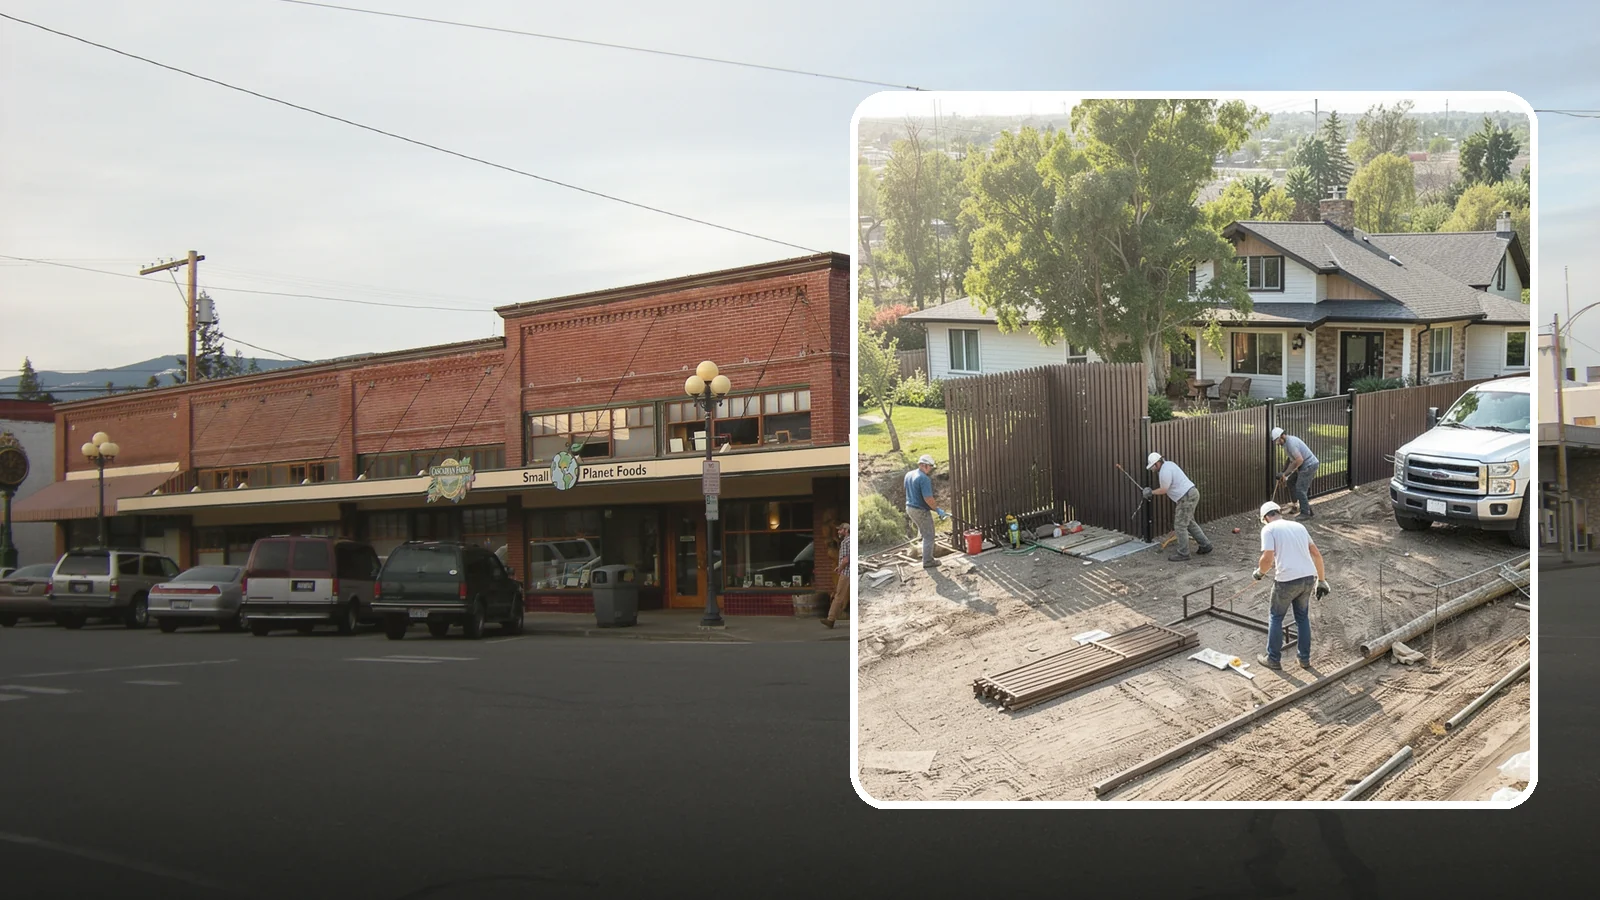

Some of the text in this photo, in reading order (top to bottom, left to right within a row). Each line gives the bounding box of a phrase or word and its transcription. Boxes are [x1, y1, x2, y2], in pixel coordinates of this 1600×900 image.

[523, 464, 647, 483] Small Planet Foods
